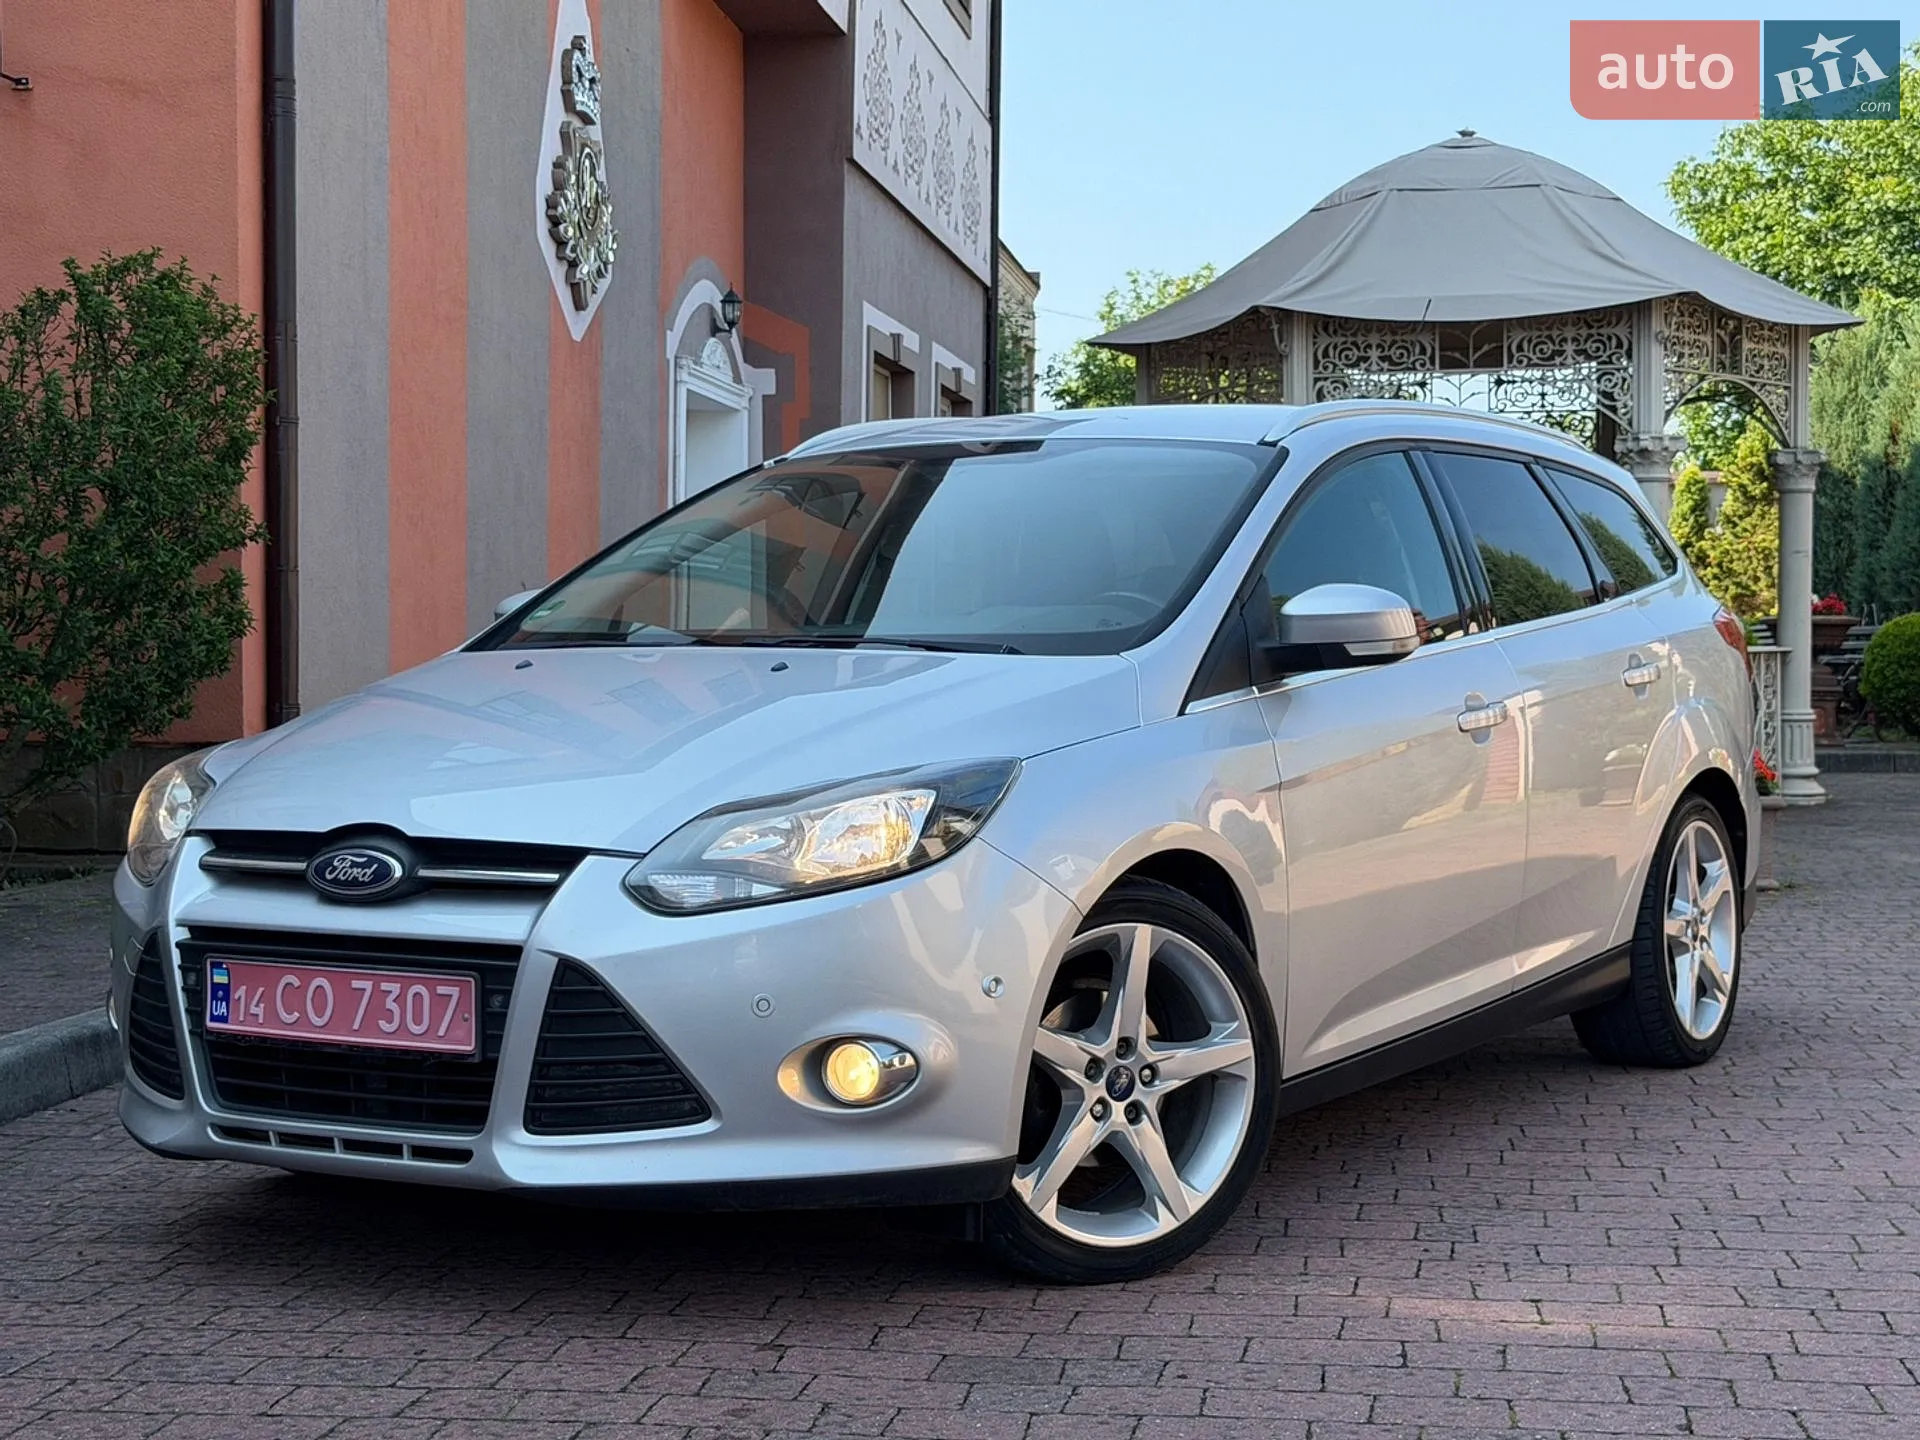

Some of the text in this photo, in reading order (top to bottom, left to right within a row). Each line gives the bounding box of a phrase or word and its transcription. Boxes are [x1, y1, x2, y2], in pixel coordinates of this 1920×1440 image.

[325, 854, 379, 883] Ford
[212, 999, 228, 1017] UA
[233, 974, 461, 1037] 14 CO 7307
